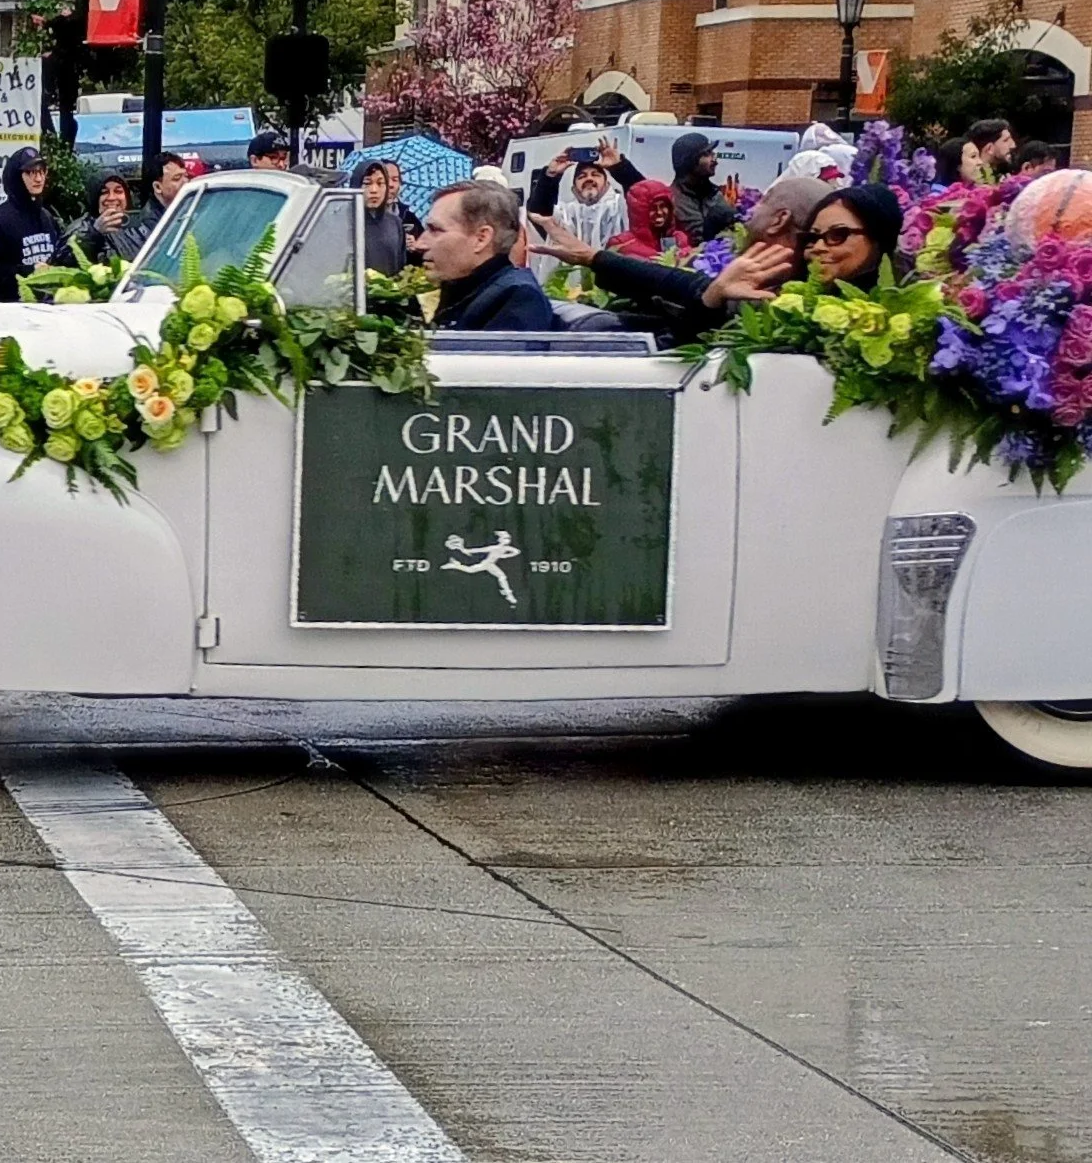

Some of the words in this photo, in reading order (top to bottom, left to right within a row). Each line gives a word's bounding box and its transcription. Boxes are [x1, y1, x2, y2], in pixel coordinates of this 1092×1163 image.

[401, 412, 574, 455] GRAND
[372, 464, 602, 506] MARSHAL
[391, 558, 431, 573] FTD
[529, 559, 572, 574] 1910
